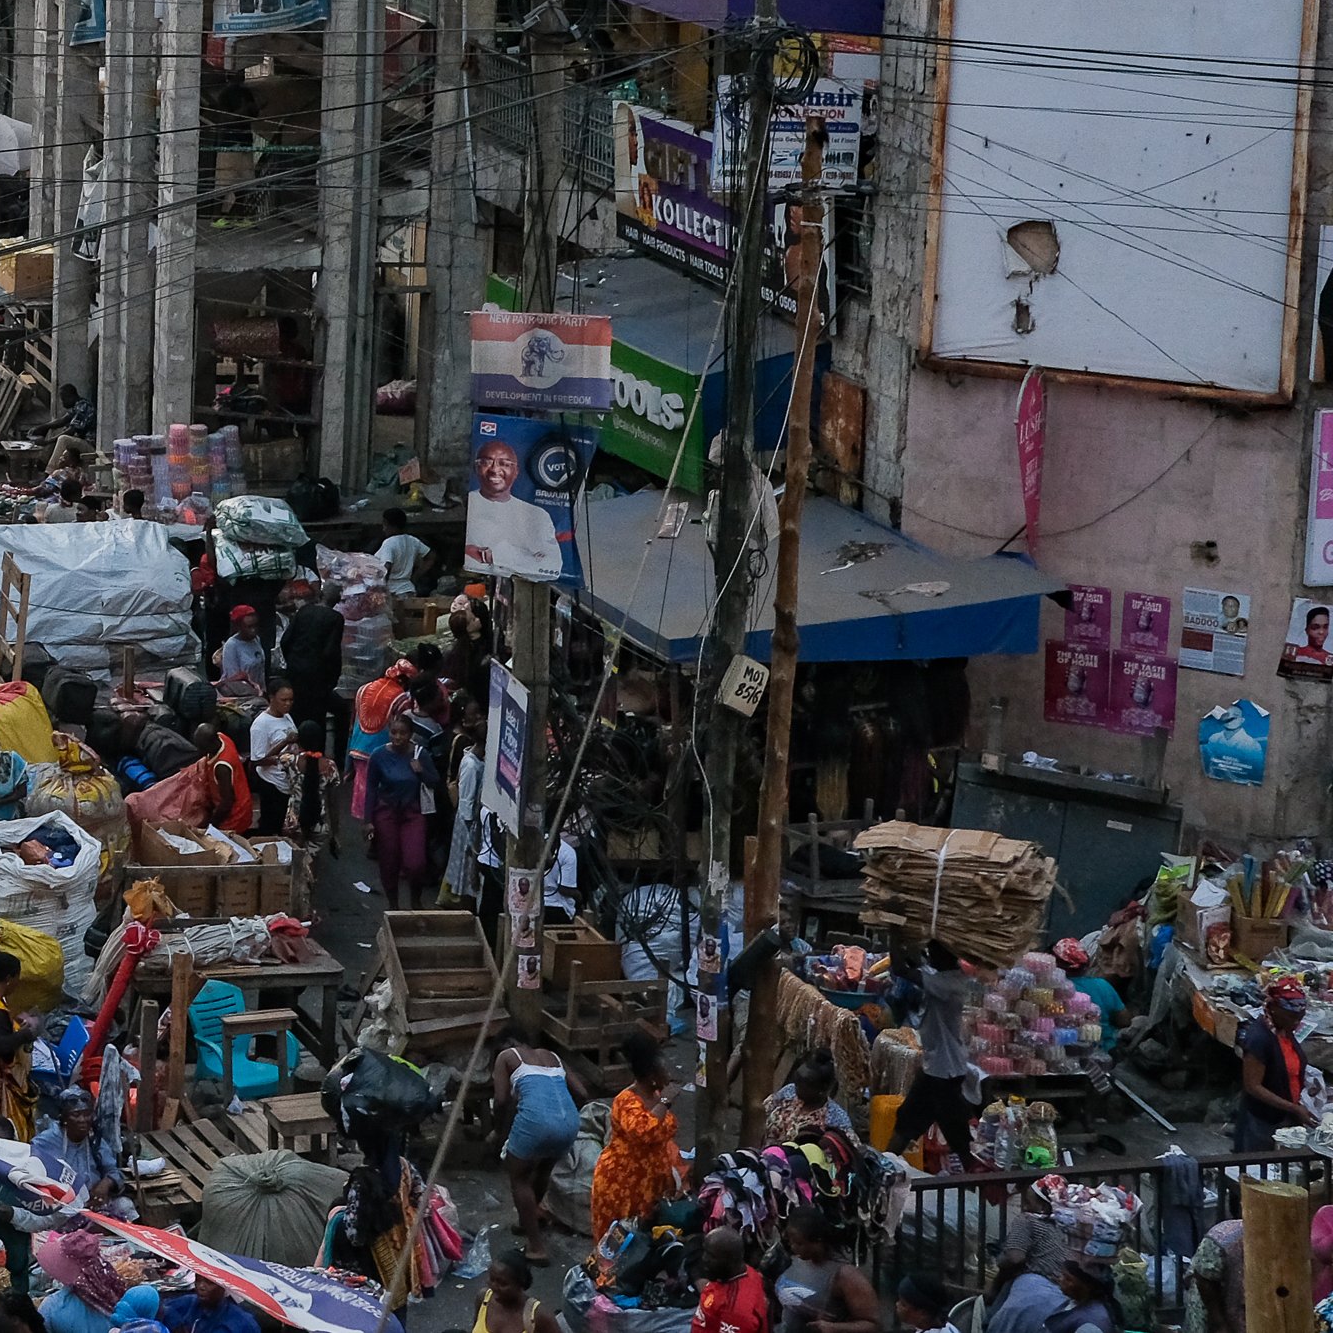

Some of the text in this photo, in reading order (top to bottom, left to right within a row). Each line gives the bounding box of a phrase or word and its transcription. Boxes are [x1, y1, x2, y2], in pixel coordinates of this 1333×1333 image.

[625, 224, 724, 280] HAIR HAIR PRODUCTS HAIR TOOLS
[489, 314, 510, 325] NEW
[559, 316, 590, 327] PARTY
[485, 390, 592, 405] DEVELOPMENT IN FREEDOM
[546, 462, 566, 472] VOT
[1184, 615, 1220, 627] BADDOO
[1074, 652, 1099, 662] TASTE
[1072, 659, 1099, 668] HOME
[1141, 663, 1166, 673] TASTE
[1138, 670, 1166, 680] HOME
